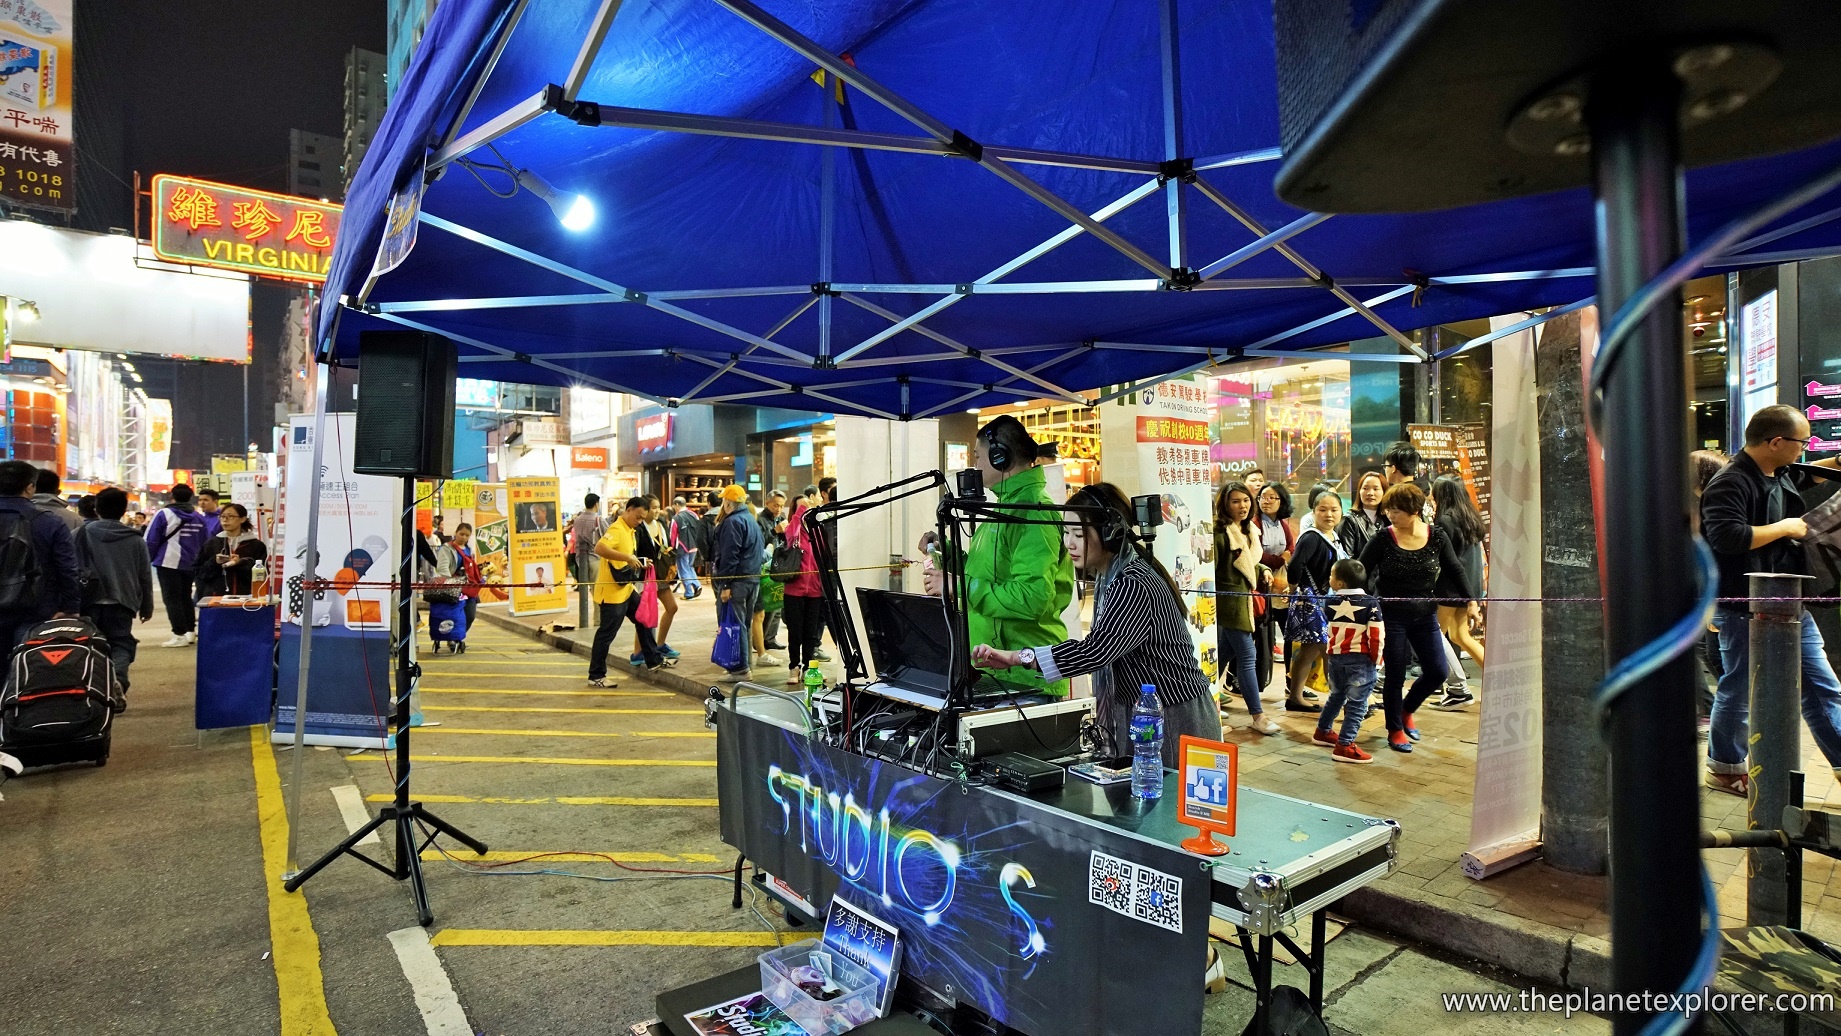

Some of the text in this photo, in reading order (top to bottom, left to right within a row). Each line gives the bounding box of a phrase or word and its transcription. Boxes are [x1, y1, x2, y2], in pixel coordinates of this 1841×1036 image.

[0, 108, 60, 136] 平喘
[16, 169, 63, 187] 1018
[168, 186, 331, 247] 維珍尼
[1434, 431, 1452, 441] DUCK
[575, 453, 603, 463] Baleno
[196, 477, 232, 494] 網上
[768, 766, 958, 917] STUDIO
[1000, 862, 1045, 961] S
[833, 907, 886, 952] 多謝支持
[838, 934, 871, 969] Thank
[840, 960, 860, 988] You
